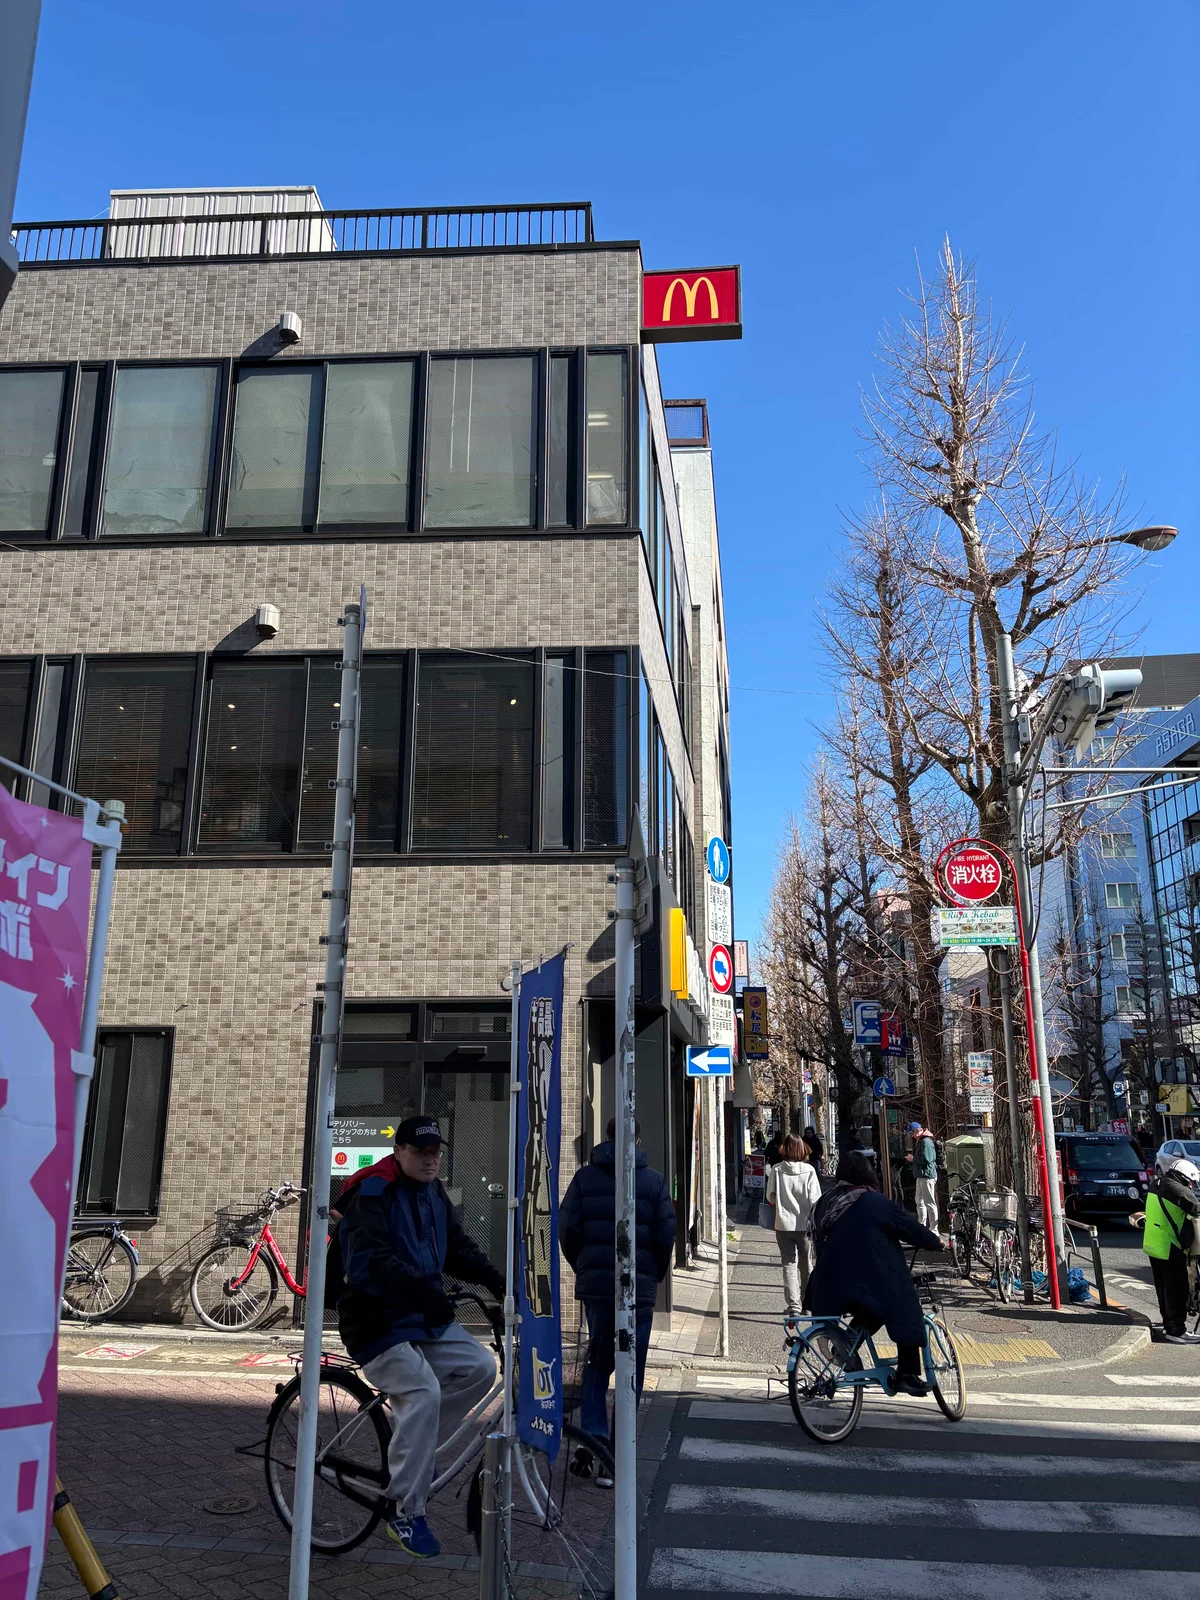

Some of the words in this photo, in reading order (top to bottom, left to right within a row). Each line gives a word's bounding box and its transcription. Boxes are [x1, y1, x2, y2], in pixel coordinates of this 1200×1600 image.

[950, 863, 997, 885] 消火栓
[970, 910, 999, 919] Kebab
[332, 1128, 377, 1136] スタッフの方は
[332, 1136, 352, 1144] こちら
